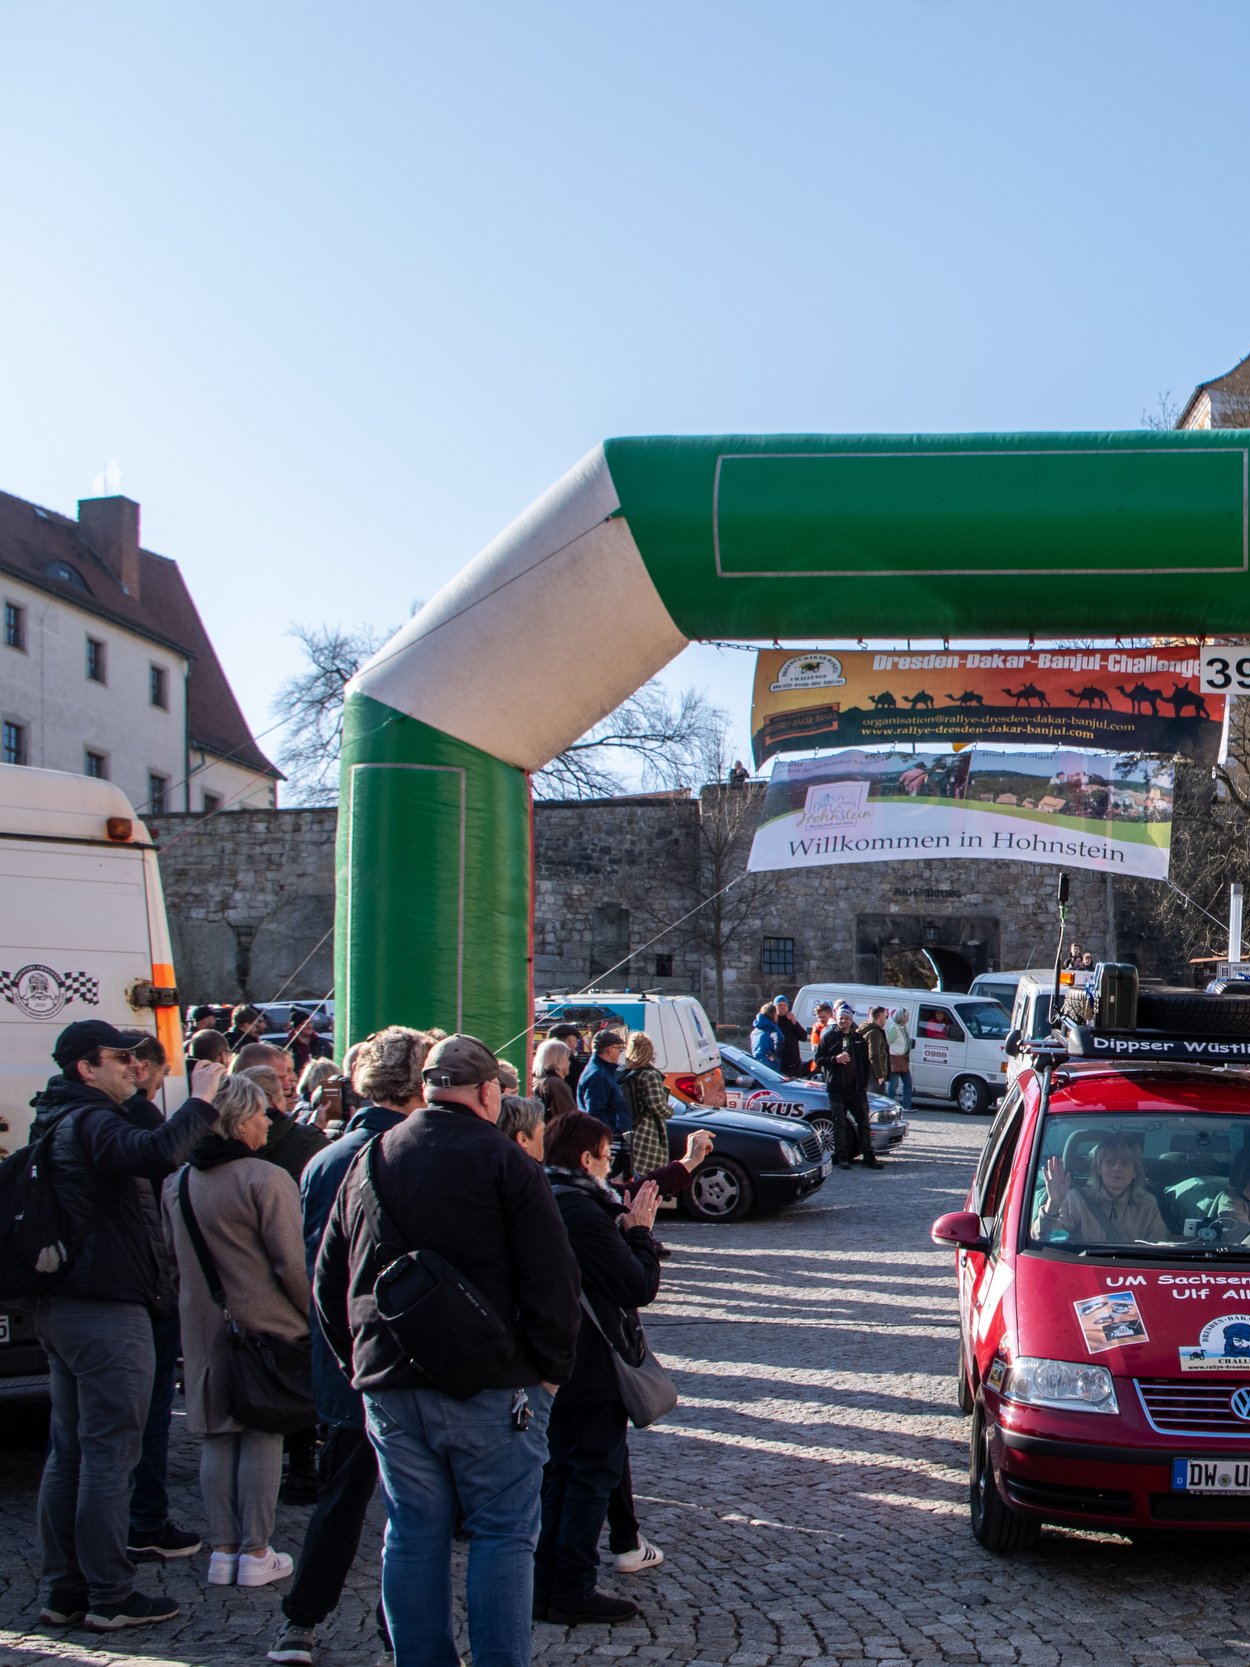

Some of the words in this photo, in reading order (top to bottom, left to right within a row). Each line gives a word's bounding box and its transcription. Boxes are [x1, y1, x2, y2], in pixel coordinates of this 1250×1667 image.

[862, 714, 1135, 731] organisation@rallye-dresden-dakar-banjul.com
[861, 724, 1095, 740] www.rallye-dresden-dakar-banjul.com
[789, 833, 950, 857] Willkommen
[960, 832, 982, 848] in
[992, 832, 1126, 863] Hohnstein
[1093, 1037, 1174, 1053] Dippser
[760, 1102, 804, 1117] KÜS
[1106, 1275, 1147, 1287] UM
[1172, 1288, 1210, 1300] Ulf
